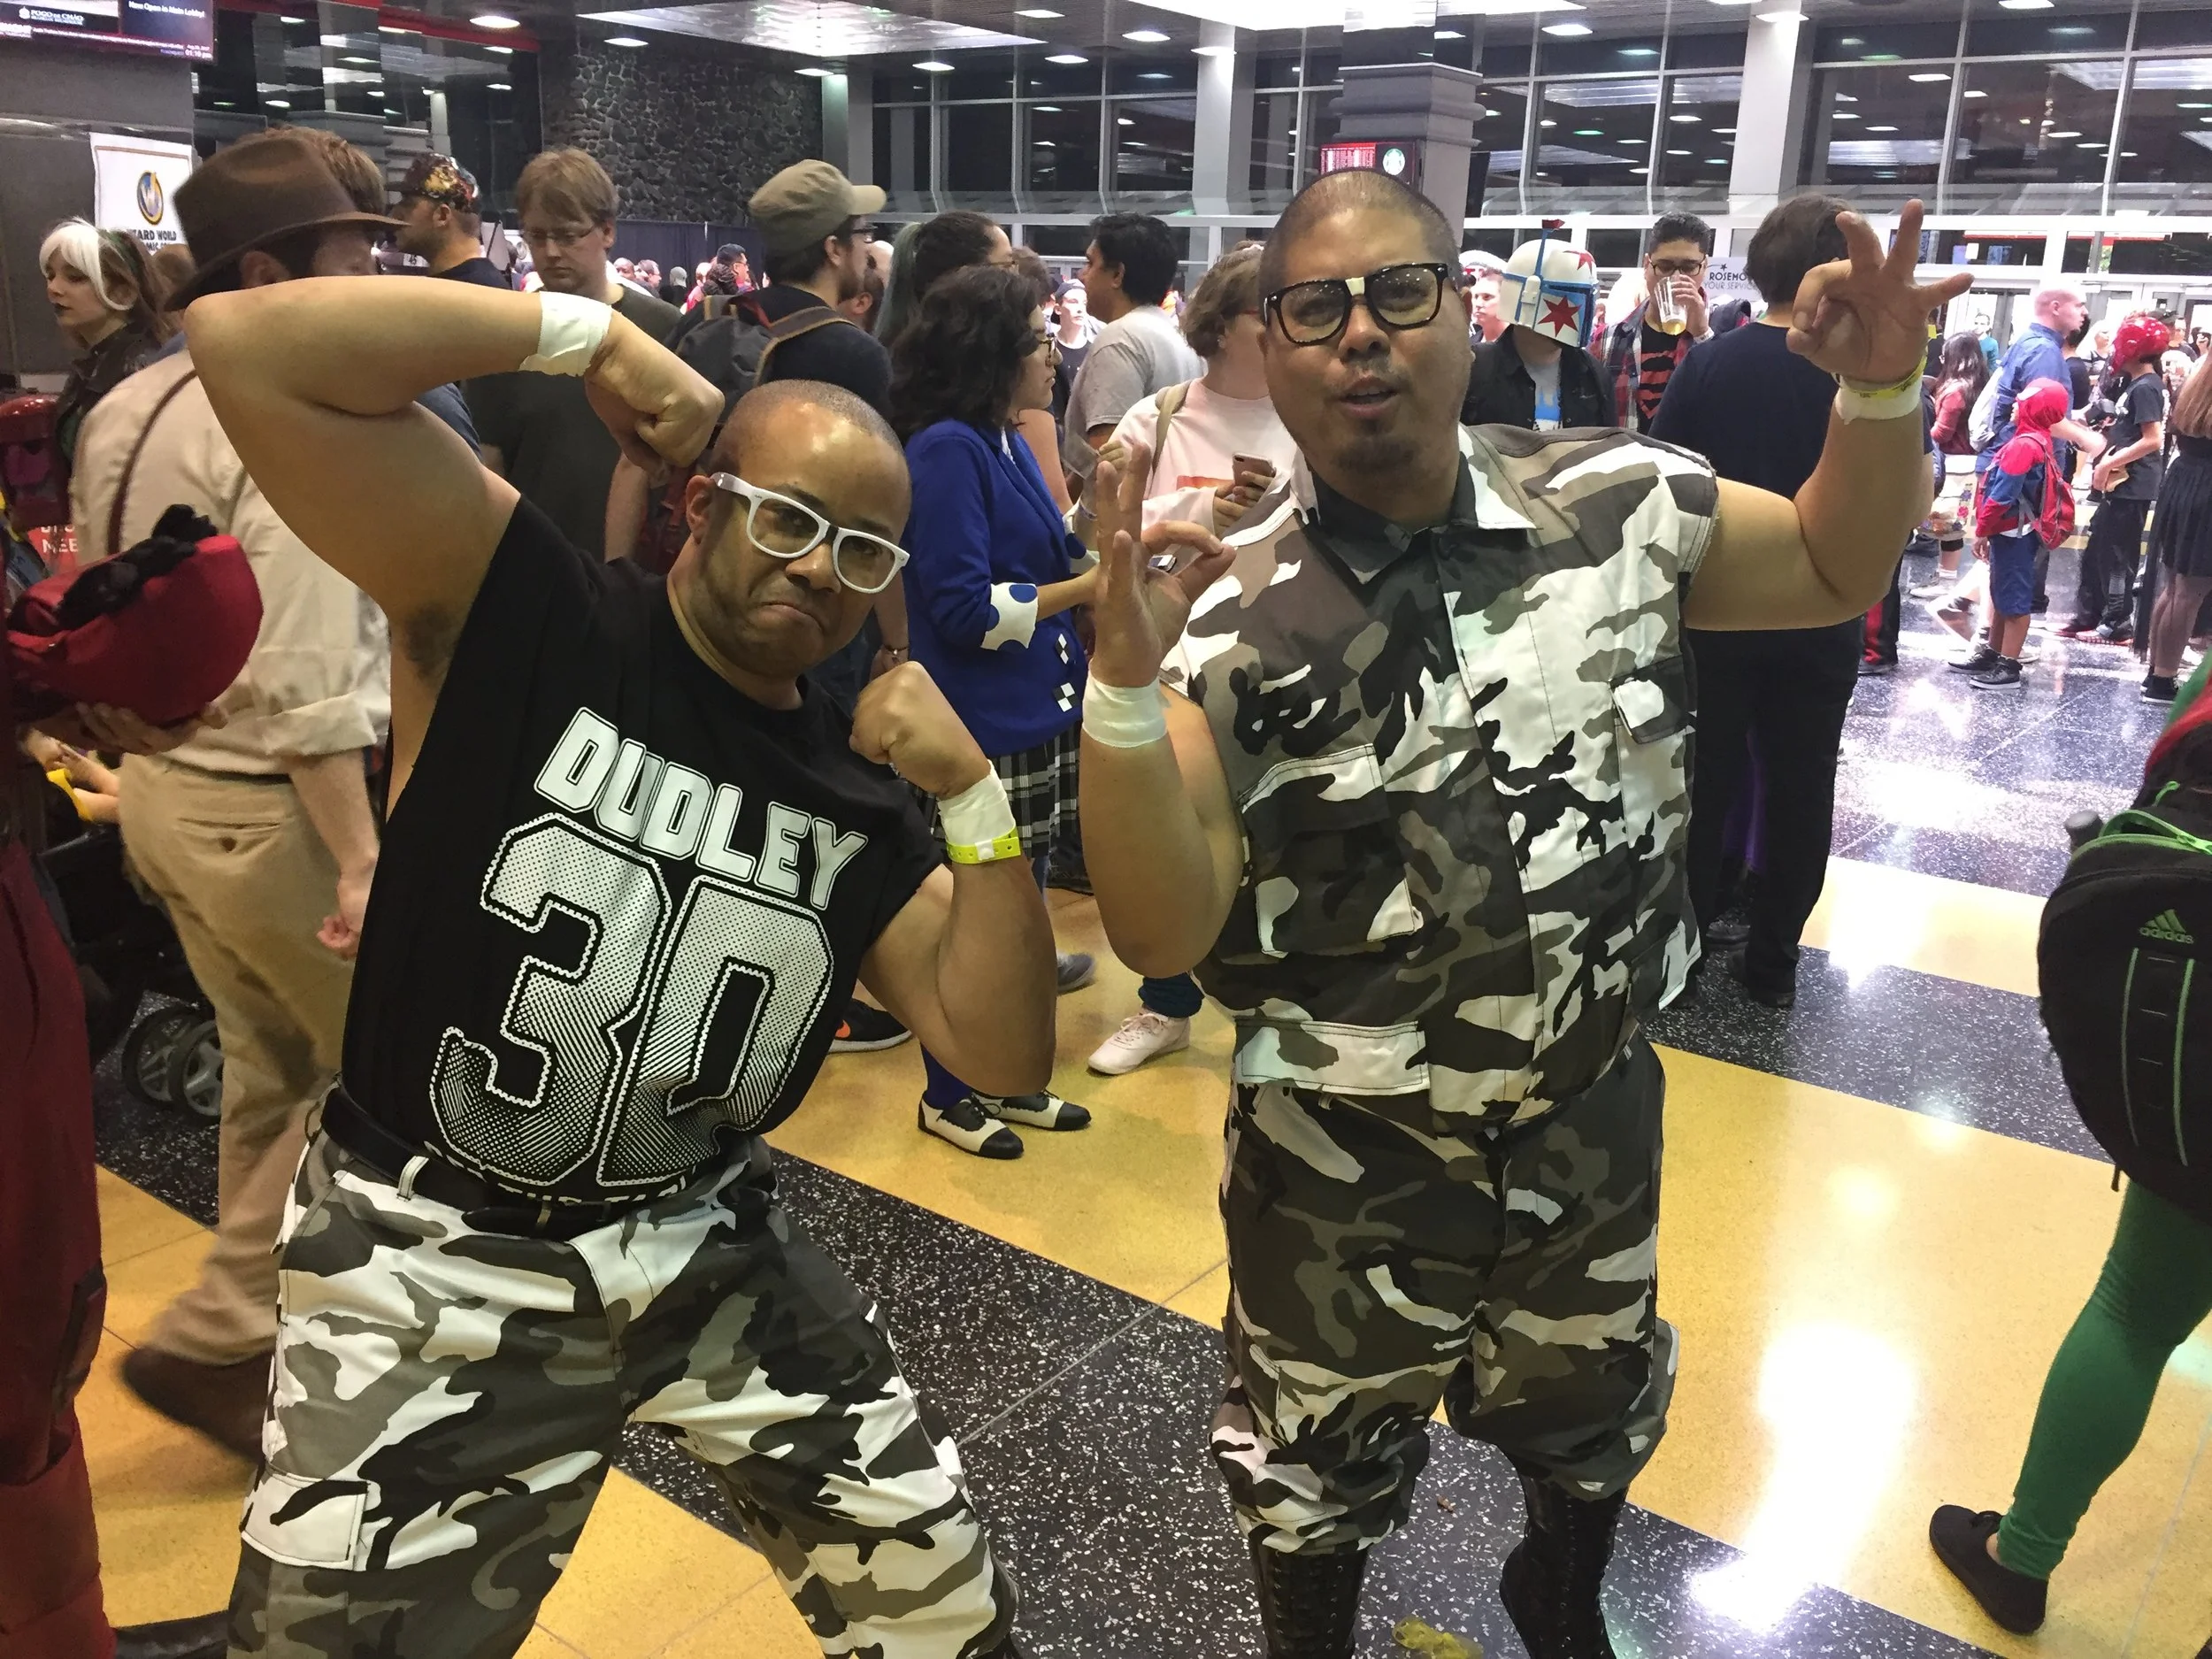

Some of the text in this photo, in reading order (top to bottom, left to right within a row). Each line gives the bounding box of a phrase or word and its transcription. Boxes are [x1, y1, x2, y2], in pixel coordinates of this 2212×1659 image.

[143, 3, 161, 12] Open
[156, 230, 177, 241] WORLD
[534, 706, 868, 911] DUDLEY
[2138, 926, 2195, 945] adidas
